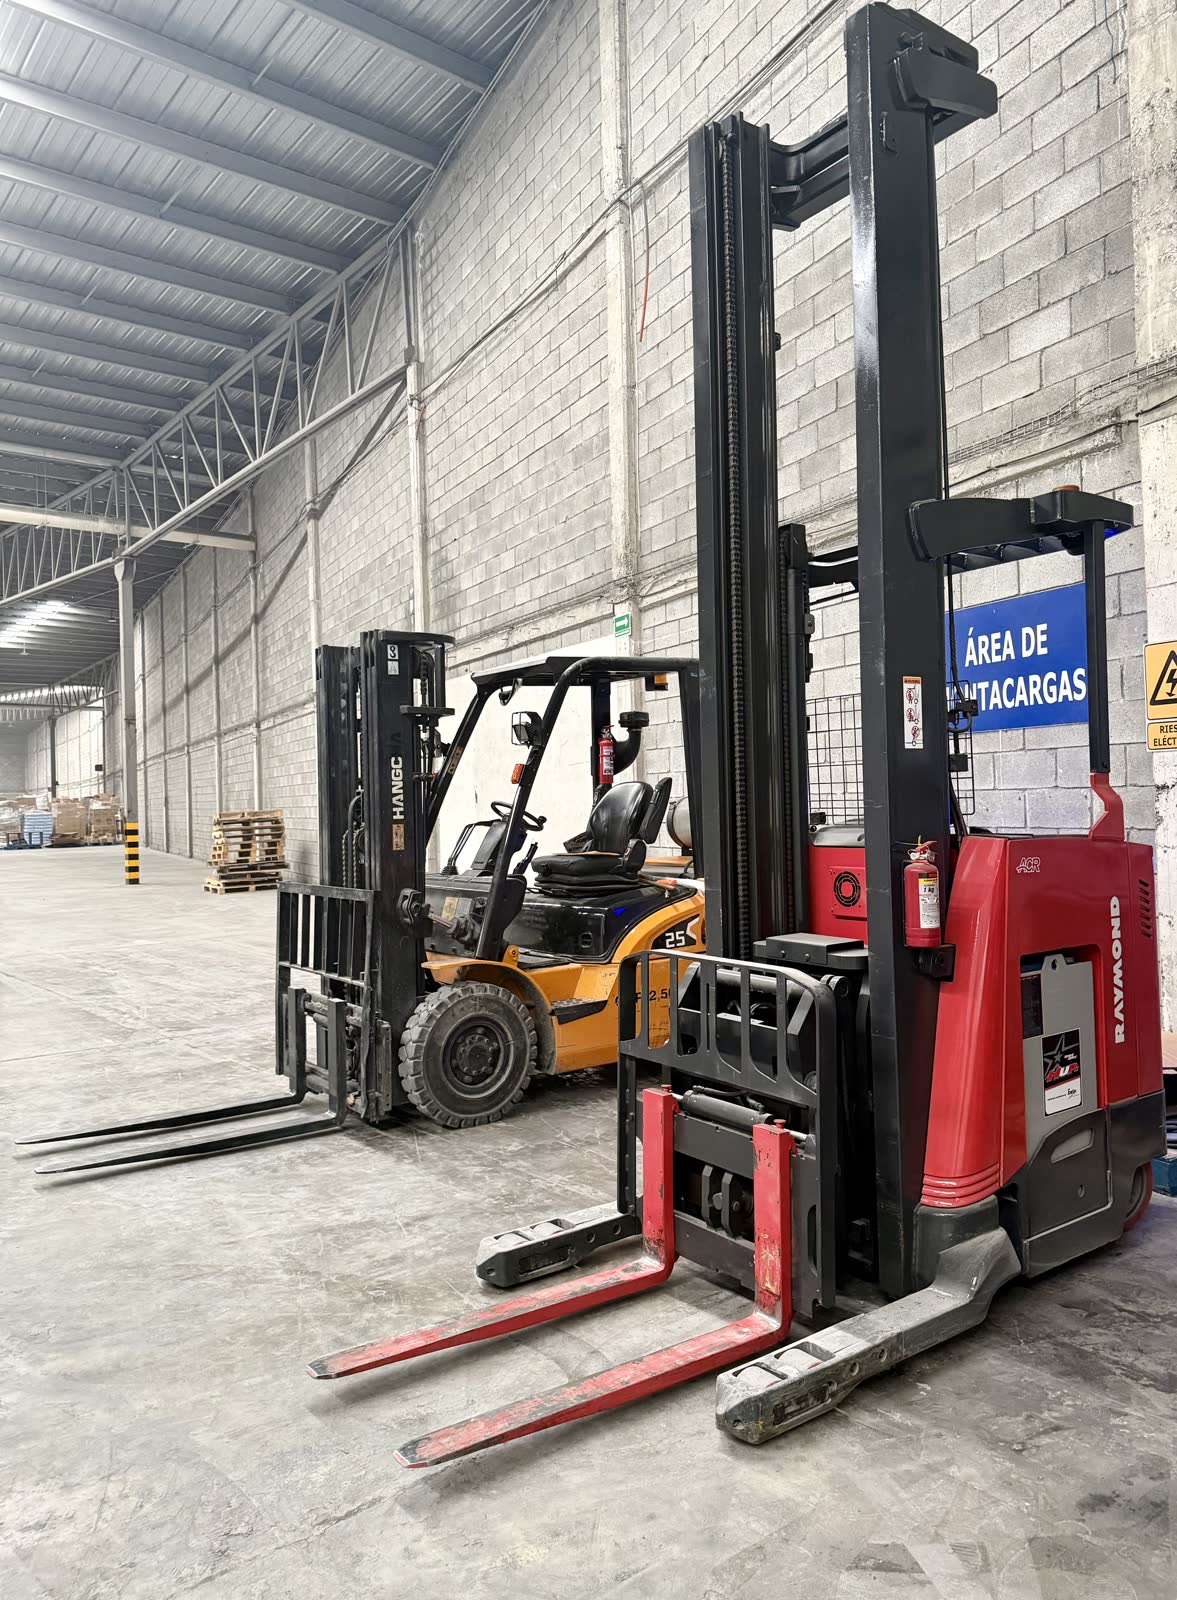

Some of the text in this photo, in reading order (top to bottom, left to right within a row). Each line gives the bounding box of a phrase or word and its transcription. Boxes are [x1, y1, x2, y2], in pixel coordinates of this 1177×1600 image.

[965, 623, 1048, 667] ÁREA DE
[1016, 856, 1041, 873] ACR
[665, 931, 686, 948] 25
[1110, 896, 1125, 1044] RAYMOND
